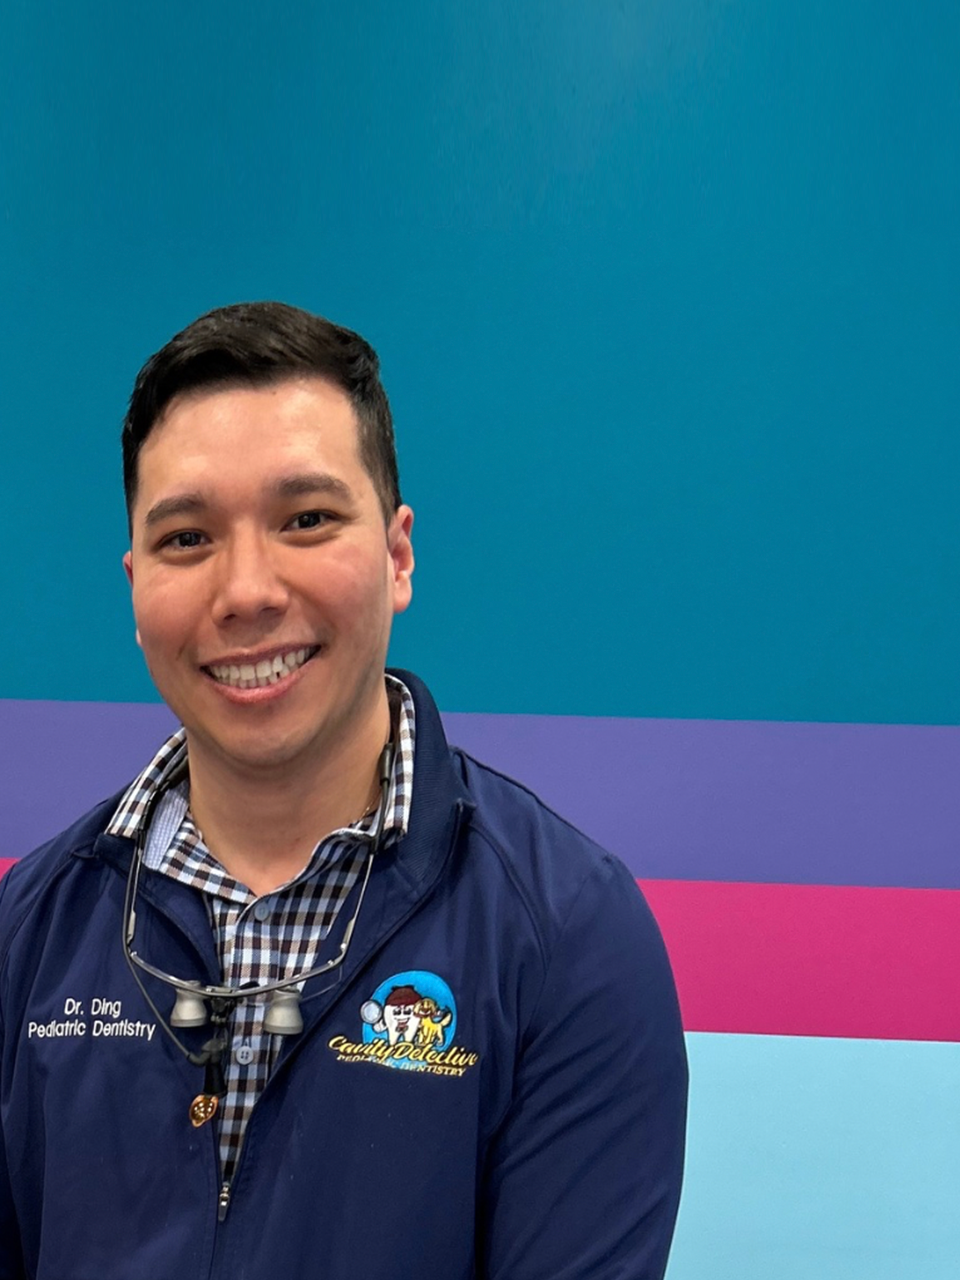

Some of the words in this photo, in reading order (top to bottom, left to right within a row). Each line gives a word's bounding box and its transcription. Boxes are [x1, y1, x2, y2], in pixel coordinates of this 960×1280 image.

[64, 998, 84, 1015] Dr.
[91, 998, 122, 1018] Ding
[28, 1019, 87, 1038] Pediatric
[92, 1018, 156, 1041] Dentistry
[328, 1035, 393, 1063] Cavity
